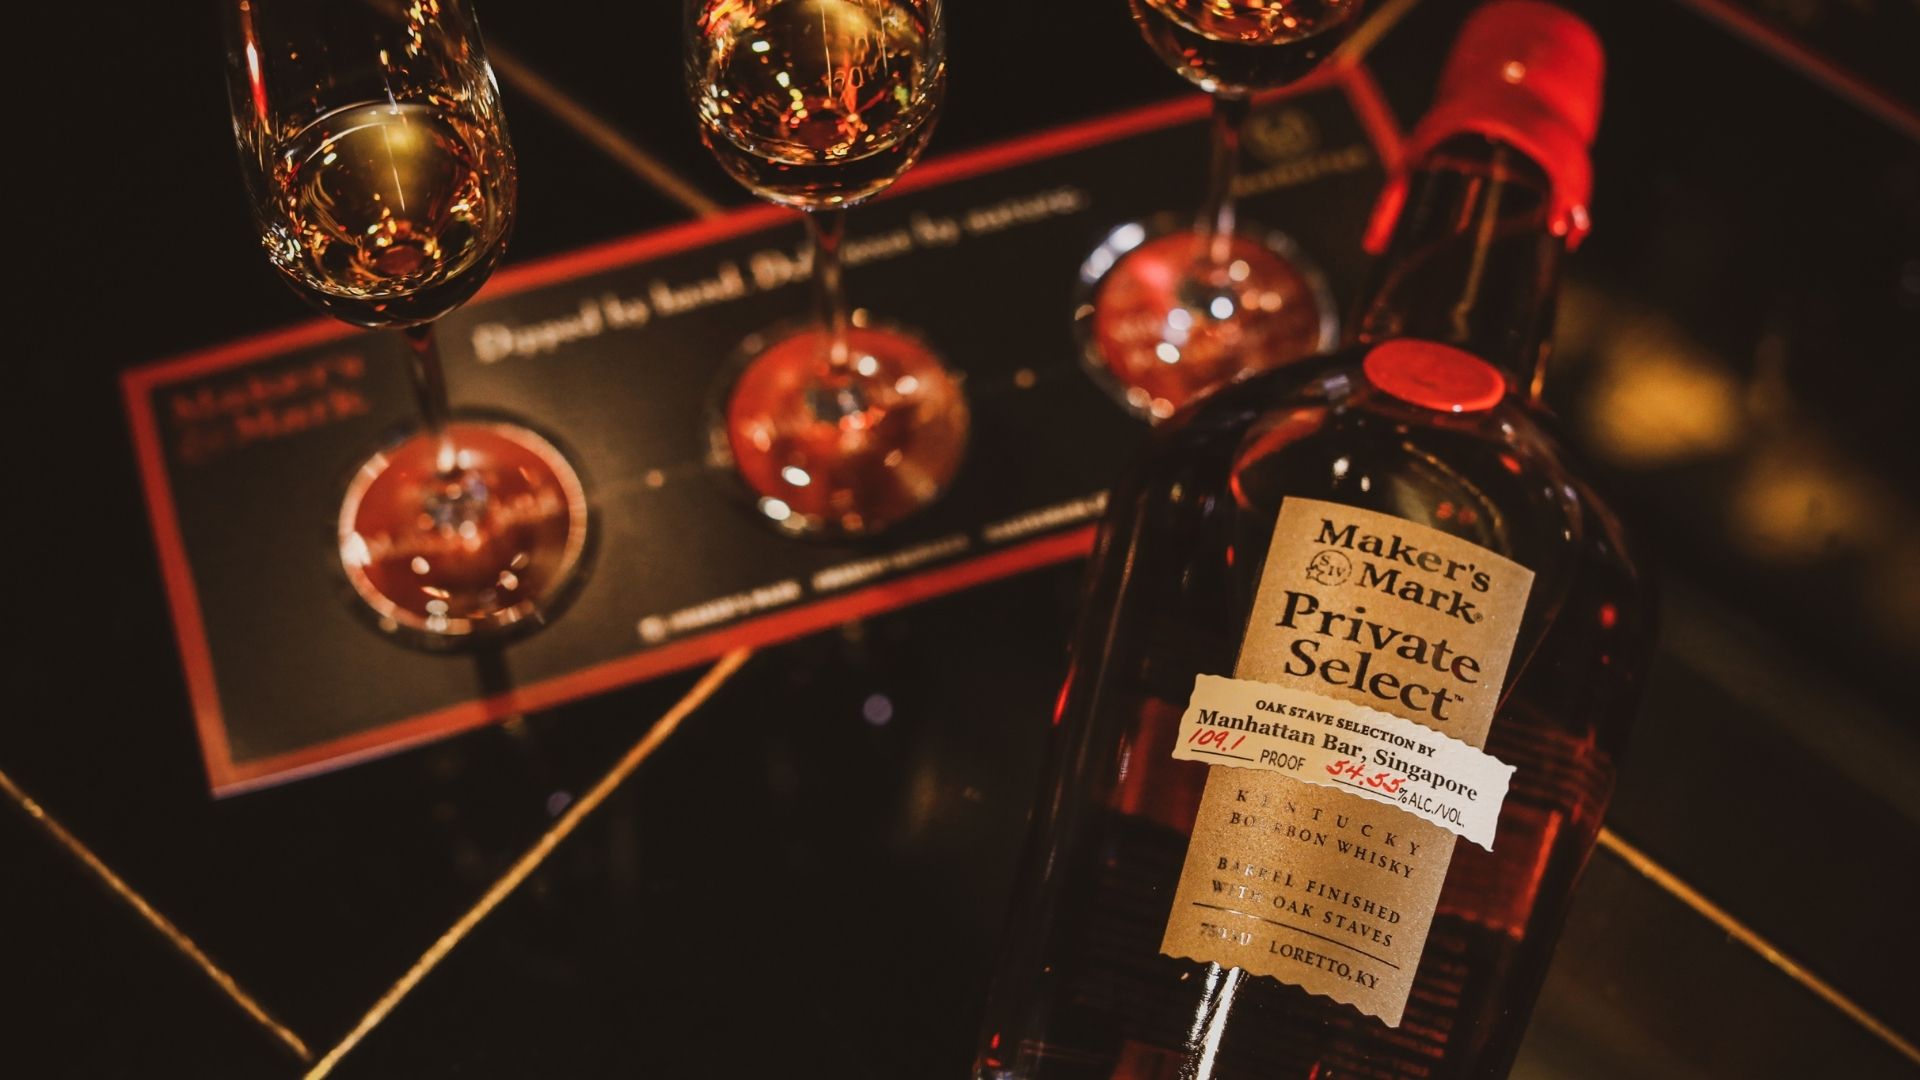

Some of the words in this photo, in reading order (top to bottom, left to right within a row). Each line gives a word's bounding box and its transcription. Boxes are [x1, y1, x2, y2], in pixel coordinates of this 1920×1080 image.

[1313, 517, 1491, 593] Maker's
[1275, 590, 1481, 684] Private
[1187, 727, 1247, 752] 109.1
[1196, 708, 1316, 746] Manhattan
[1322, 732, 1368, 763] Bar,
[1373, 748, 1478, 801] Singapore
[1255, 699, 1287, 715] OAK
[1288, 706, 1334, 726] STAVE
[1335, 718, 1416, 750] SELECTION
[1417, 742, 1437, 758] BY
[1259, 748, 1306, 771] PROOF
[1325, 759, 1407, 794] 54.55
[1229, 811, 1327, 848] BORBON
[1337, 839, 1415, 879] WHISKY
[1273, 895, 1315, 918] OAK
[1322, 910, 1393, 947] STAVES
[1305, 879, 1401, 924] FINISHED
[1269, 940, 1352, 981] LORETTO,
[1355, 969, 1380, 990] KY
